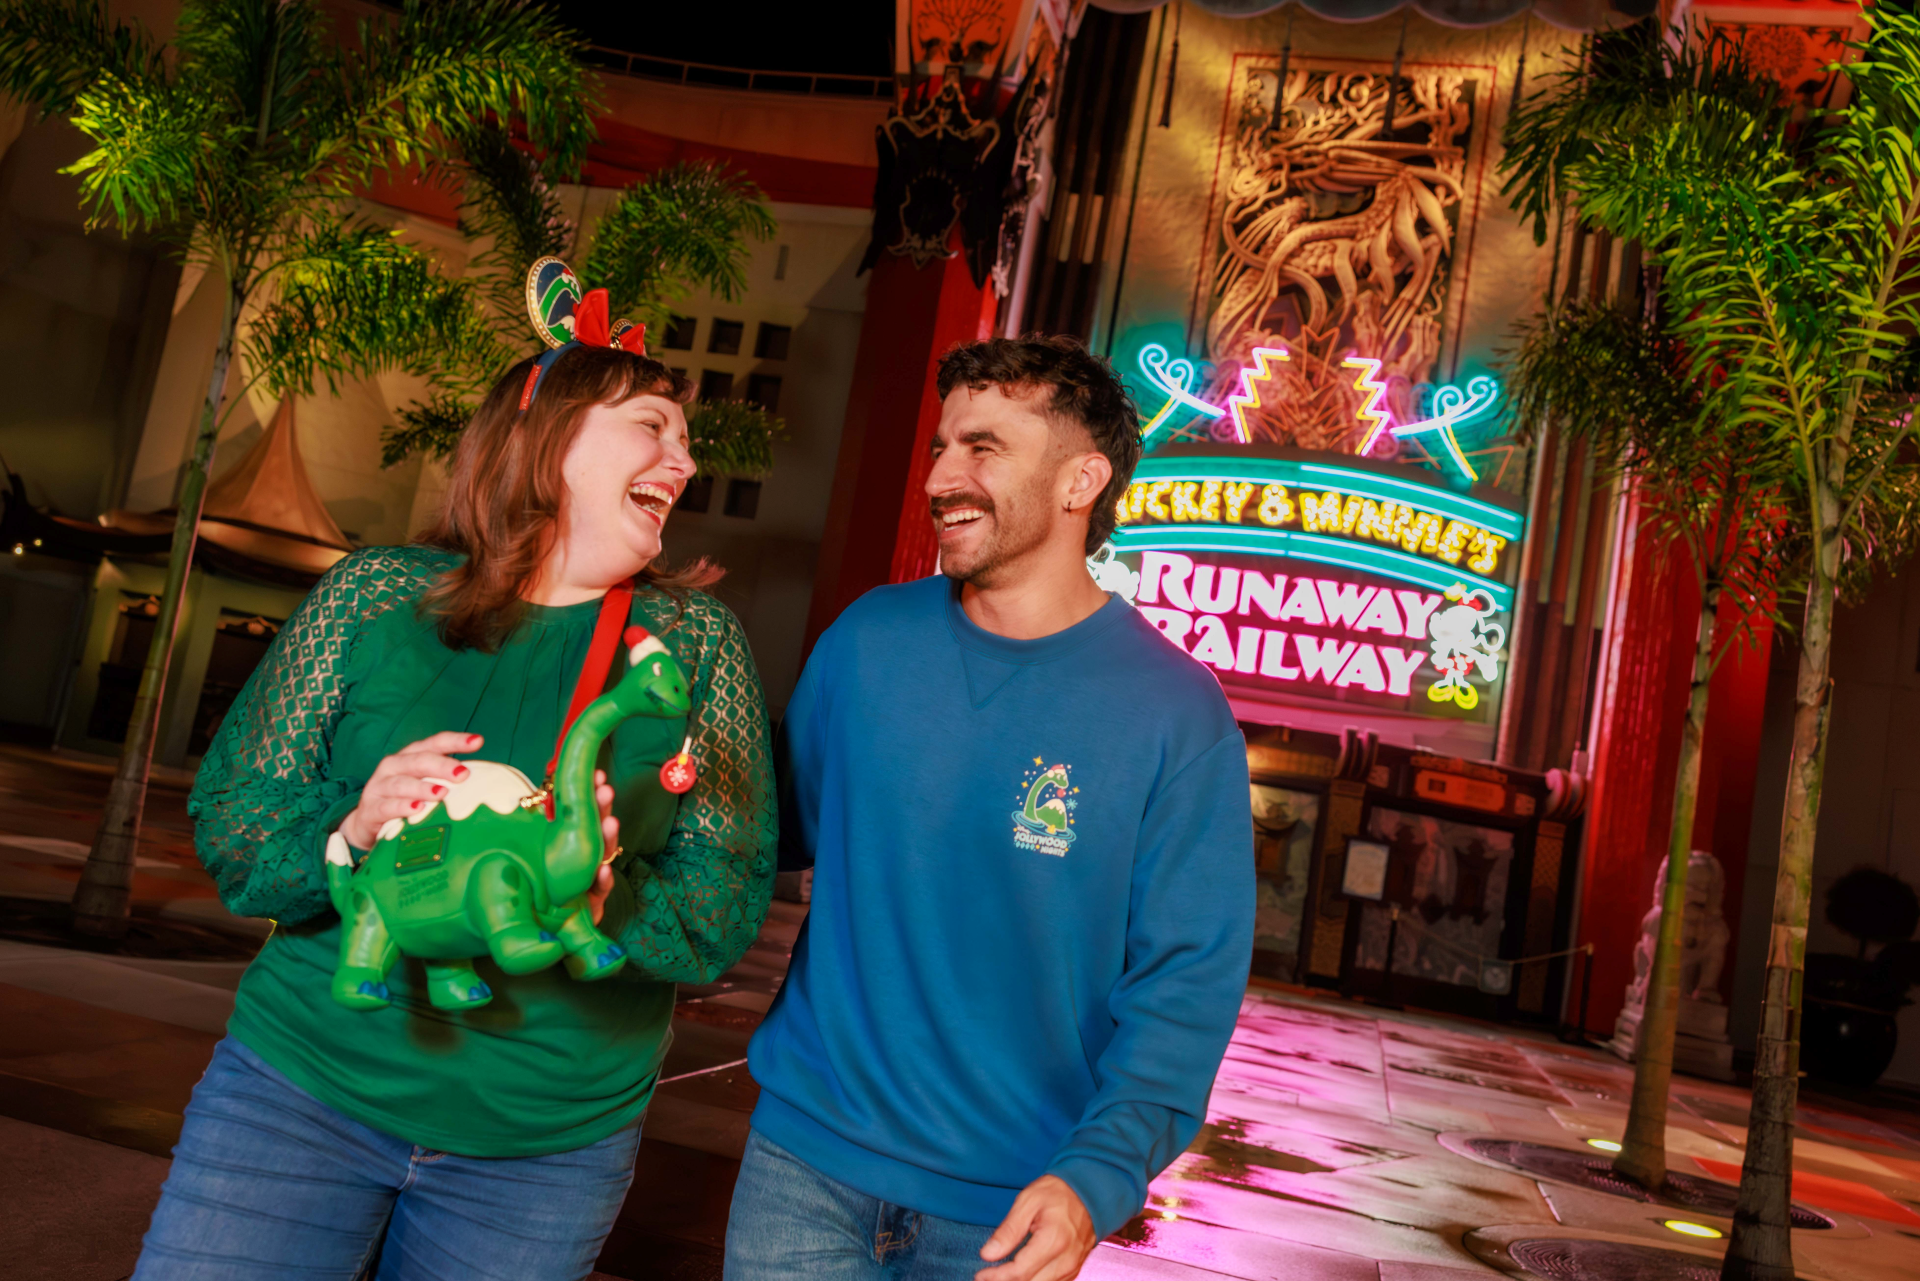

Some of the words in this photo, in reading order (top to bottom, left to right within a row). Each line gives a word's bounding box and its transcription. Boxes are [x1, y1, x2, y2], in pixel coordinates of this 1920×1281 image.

[1258, 484, 1295, 525] &
[1298, 492, 1507, 574] MINNIE'S
[1137, 550, 1443, 639] RUNAWAY
[1014, 831, 1067, 848] JOLLYWOOD
